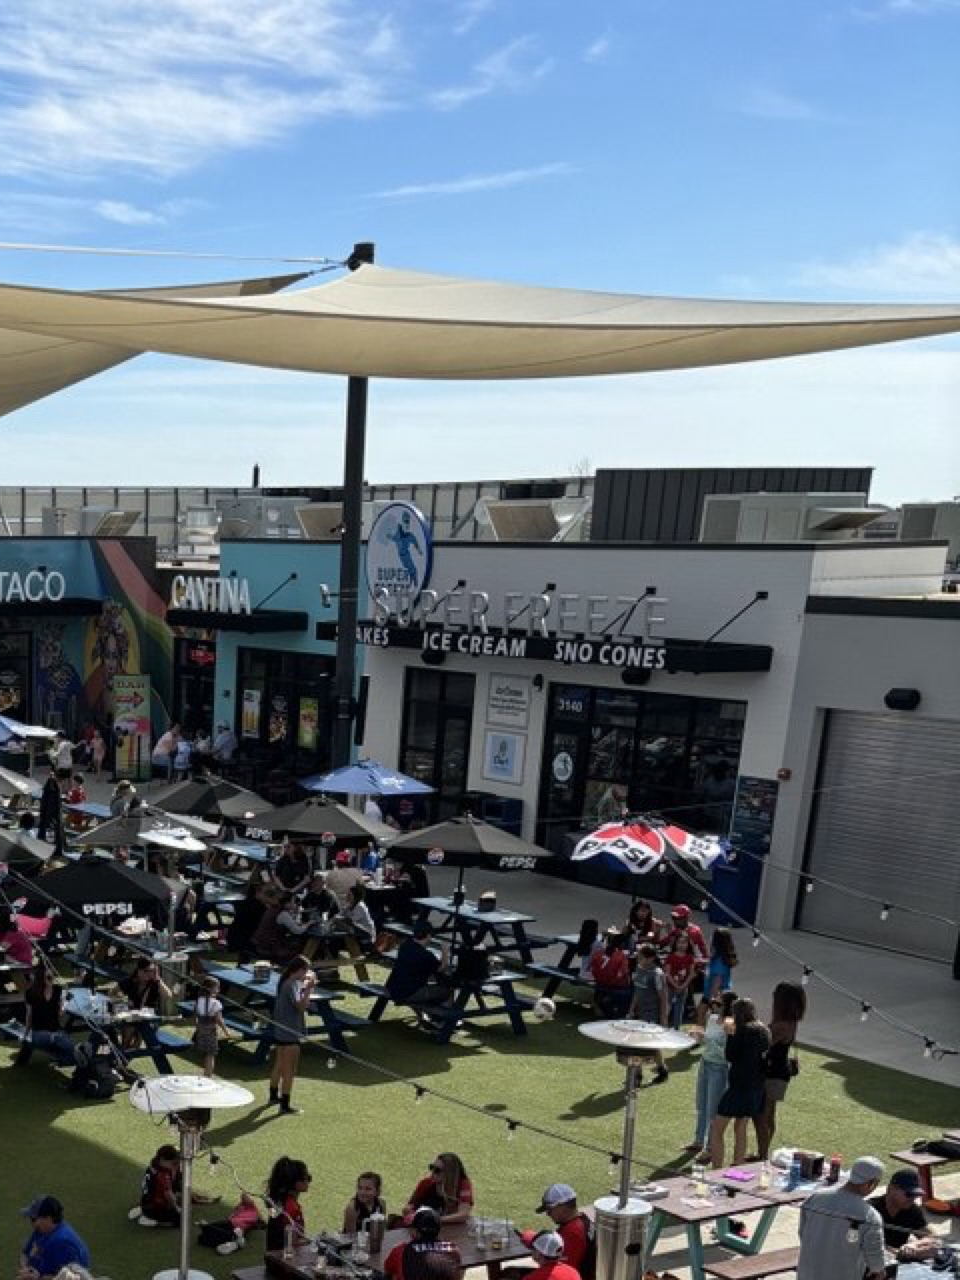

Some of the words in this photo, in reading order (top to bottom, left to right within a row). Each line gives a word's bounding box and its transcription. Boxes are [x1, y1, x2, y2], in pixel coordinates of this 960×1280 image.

[172, 575, 251, 615] CANTINA
[373, 586, 490, 634] SUPER
[503, 590, 670, 646] FREEZE
[423, 631, 453, 651] ICE
[457, 635, 527, 658] CREAM
[554, 640, 593, 664] SNO
[599, 644, 668, 670] CONES
[499, 855, 537, 870] PEPSI
[82, 902, 133, 915] PEPSI
